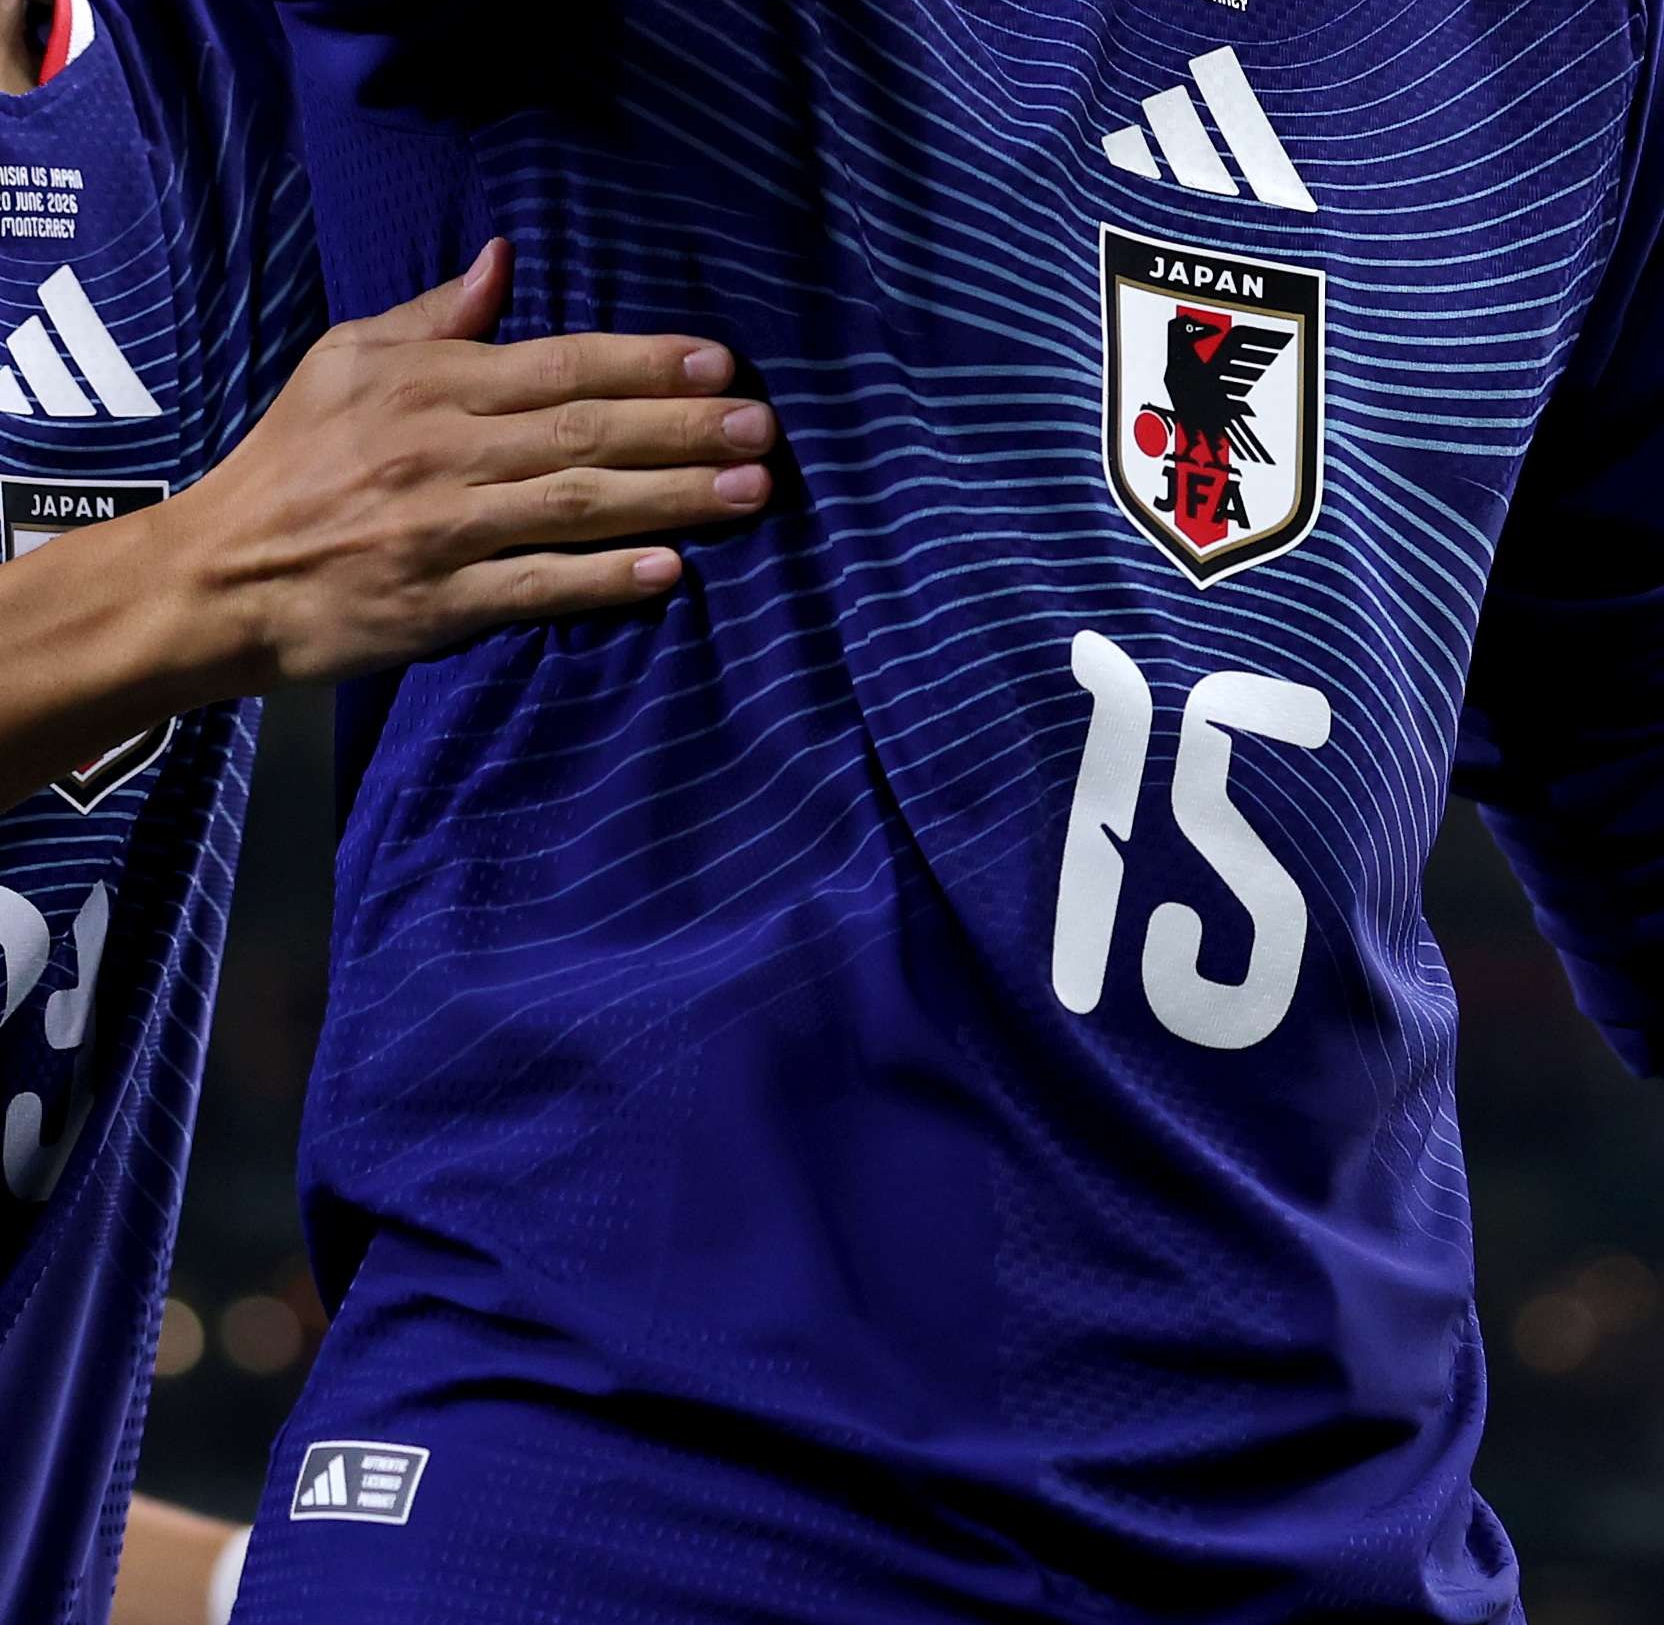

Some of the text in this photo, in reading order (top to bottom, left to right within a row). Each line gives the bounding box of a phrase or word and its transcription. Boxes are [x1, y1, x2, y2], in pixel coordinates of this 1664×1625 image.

[50, 167, 84, 190] JAPAN
[15, 191, 45, 212] JUNE
[47, 192, 79, 214] 2026
[1, 216, 76, 239] MONTERREY
[1148, 256, 1264, 299] JAPAN
[30, 493, 116, 519] JAPAN
[1152, 465, 1251, 530] JFA
[1051, 629, 1332, 1050] 15
